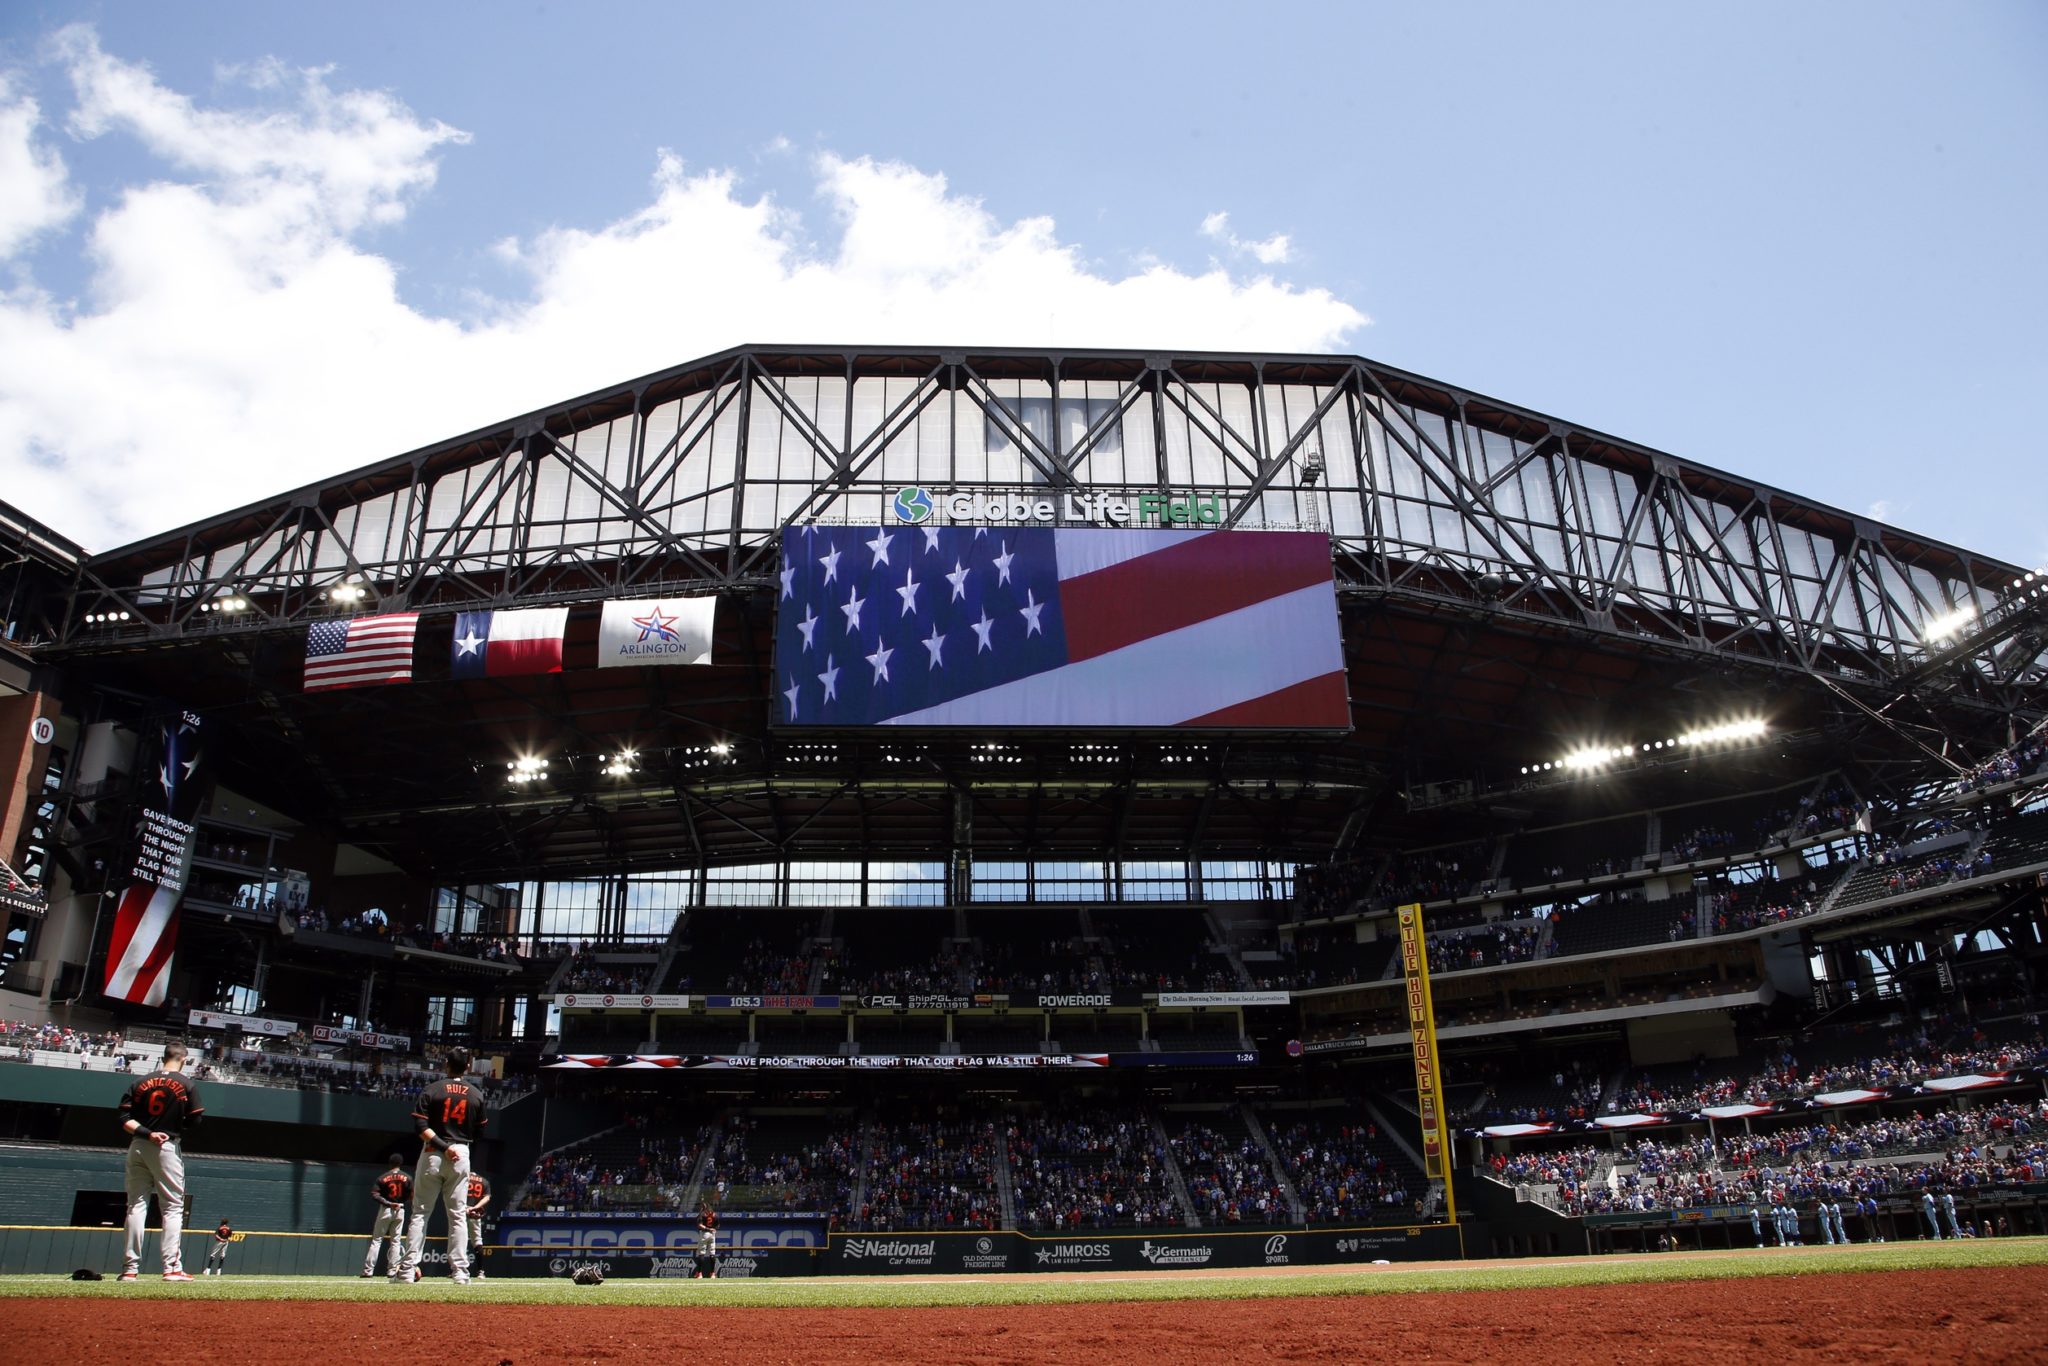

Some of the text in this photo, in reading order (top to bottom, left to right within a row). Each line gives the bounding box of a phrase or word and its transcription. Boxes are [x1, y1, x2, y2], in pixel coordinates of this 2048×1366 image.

[945, 493, 1222, 523] Globe Life Field
[619, 643, 687, 655] ARLINGTON
[181, 710, 201, 726] 1:26
[36, 722, 50, 739] 10
[143, 808, 195, 834] GAVE PROOF
[147, 822, 187, 843] THROUGH
[143, 833, 186, 855] THE NIGHT
[141, 844, 183, 867] THAT OUR
[137, 856, 181, 878] FLAG WAS
[132, 868, 182, 891] STILL THERE
[13, 899, 45, 914] RESORTS
[1403, 928, 1417, 970] THE
[1935, 961, 1948, 988] TRULY
[730, 997, 814, 1008] 105.3 THE FAN
[871, 995, 902, 1006] PGL
[1038, 995, 1112, 1007] POWERADE
[1409, 978, 1422, 1021] HOT
[728, 1056, 1073, 1066] GAVE PROOF THROUGH THE NIGHT THAT OUR FLAG WAS STILL THERE
[1236, 1053, 1254, 1062] 1:26
[1415, 1030, 1430, 1088] ZONE
[445, 1083, 470, 1096] RUIZ
[148, 1089, 166, 1116] 6
[442, 1097, 468, 1125] 14
[388, 1182, 403, 1198] 31
[467, 1183, 483, 1198] 29
[707, 1216, 713, 1226] 2
[506, 1229, 655, 1257] GEICO
[665, 1230, 815, 1257] GEICO
[864, 1240, 935, 1257] National
[1160, 1245, 1212, 1257] Germania
[422, 1249, 449, 1263] obe
[662, 1258, 690, 1268] ARROW
[722, 1258, 751, 1268] ARROW
[889, 1257, 932, 1265] Car Rental
[1265, 1255, 1289, 1264] SPORTS
